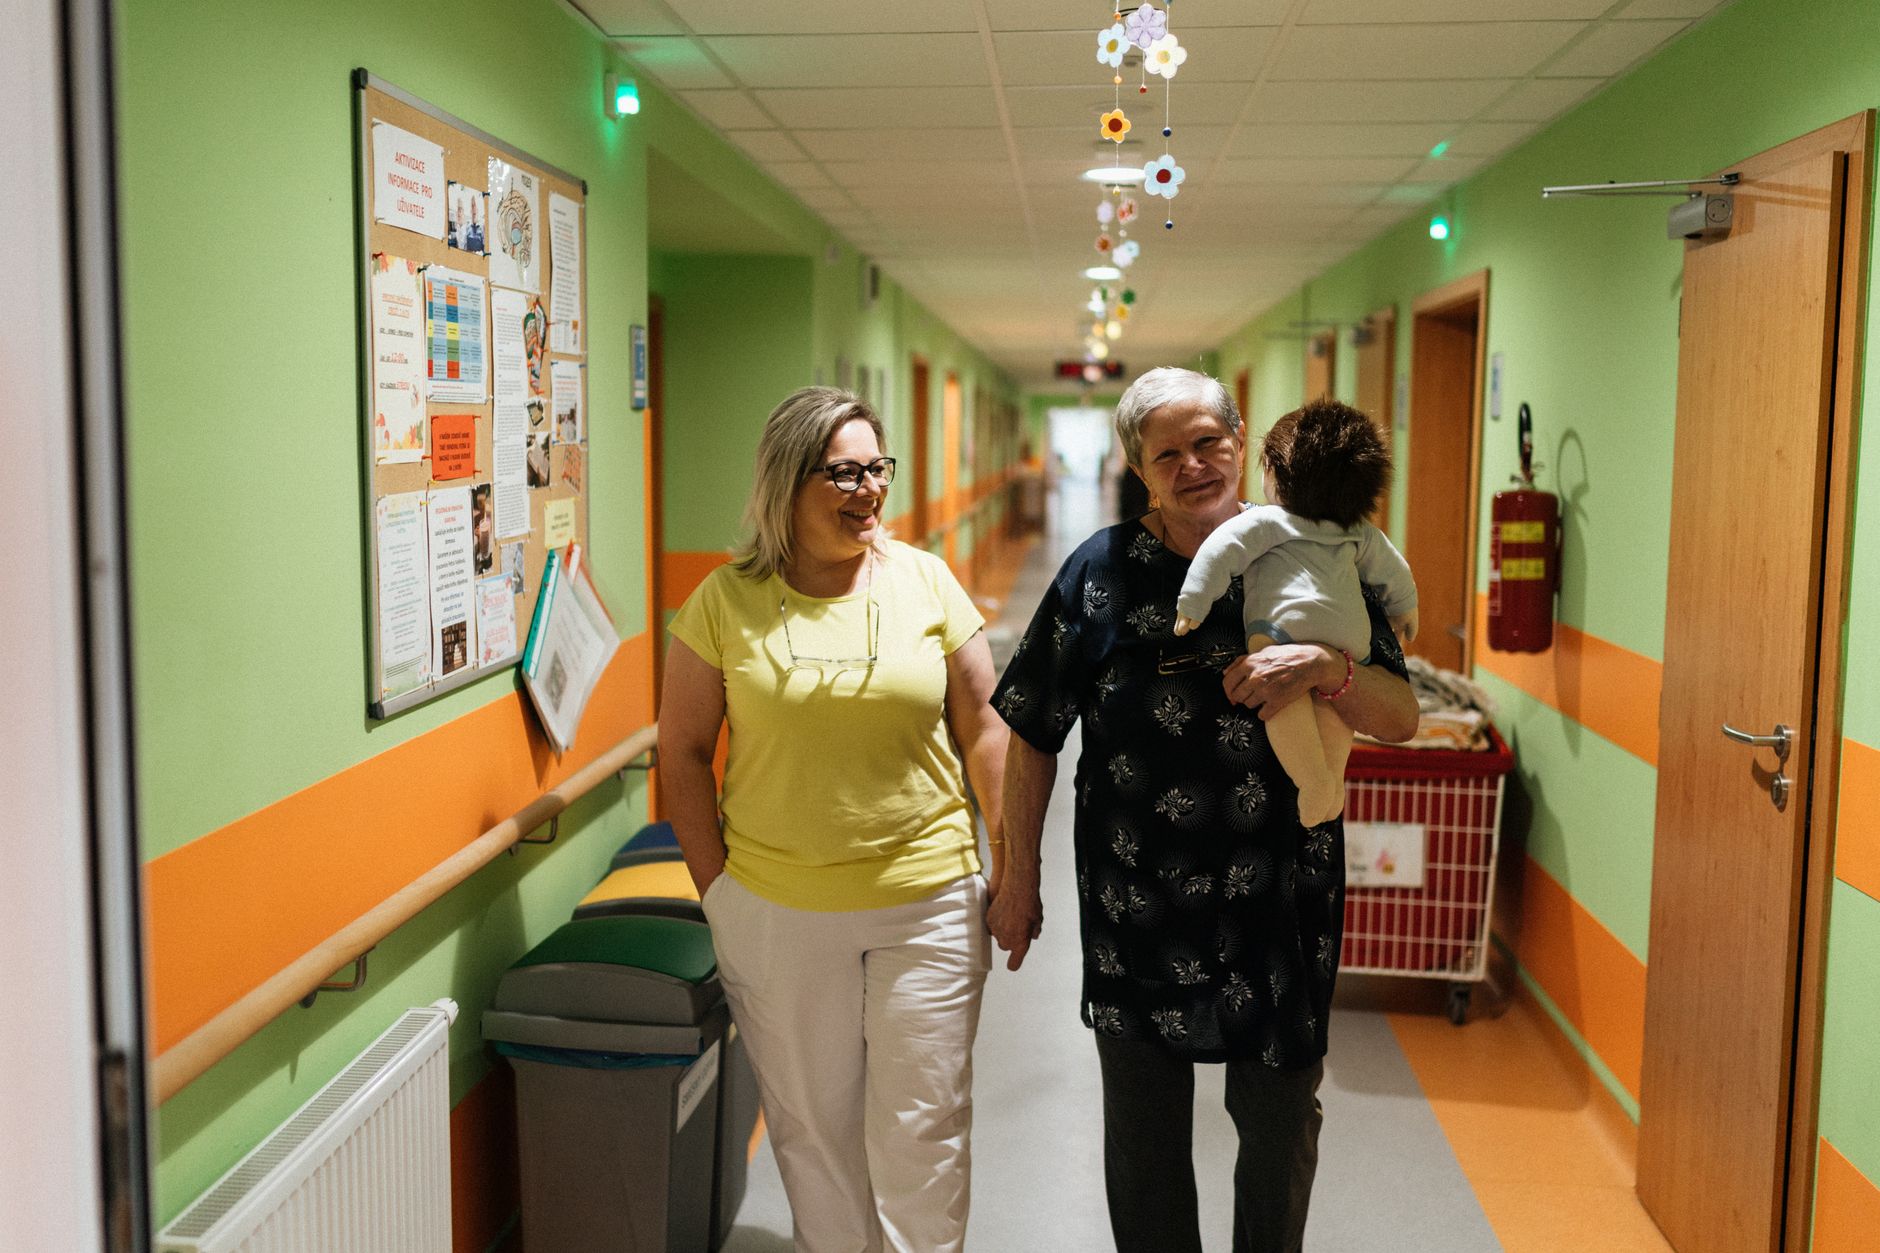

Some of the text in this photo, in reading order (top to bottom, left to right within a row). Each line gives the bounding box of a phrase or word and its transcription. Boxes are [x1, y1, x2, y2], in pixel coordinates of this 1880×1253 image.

[394, 151, 425, 174] AKTIVIZACE
[387, 171, 433, 199] INFORMACE PRO
[396, 197, 425, 219] UŽIVATELE
